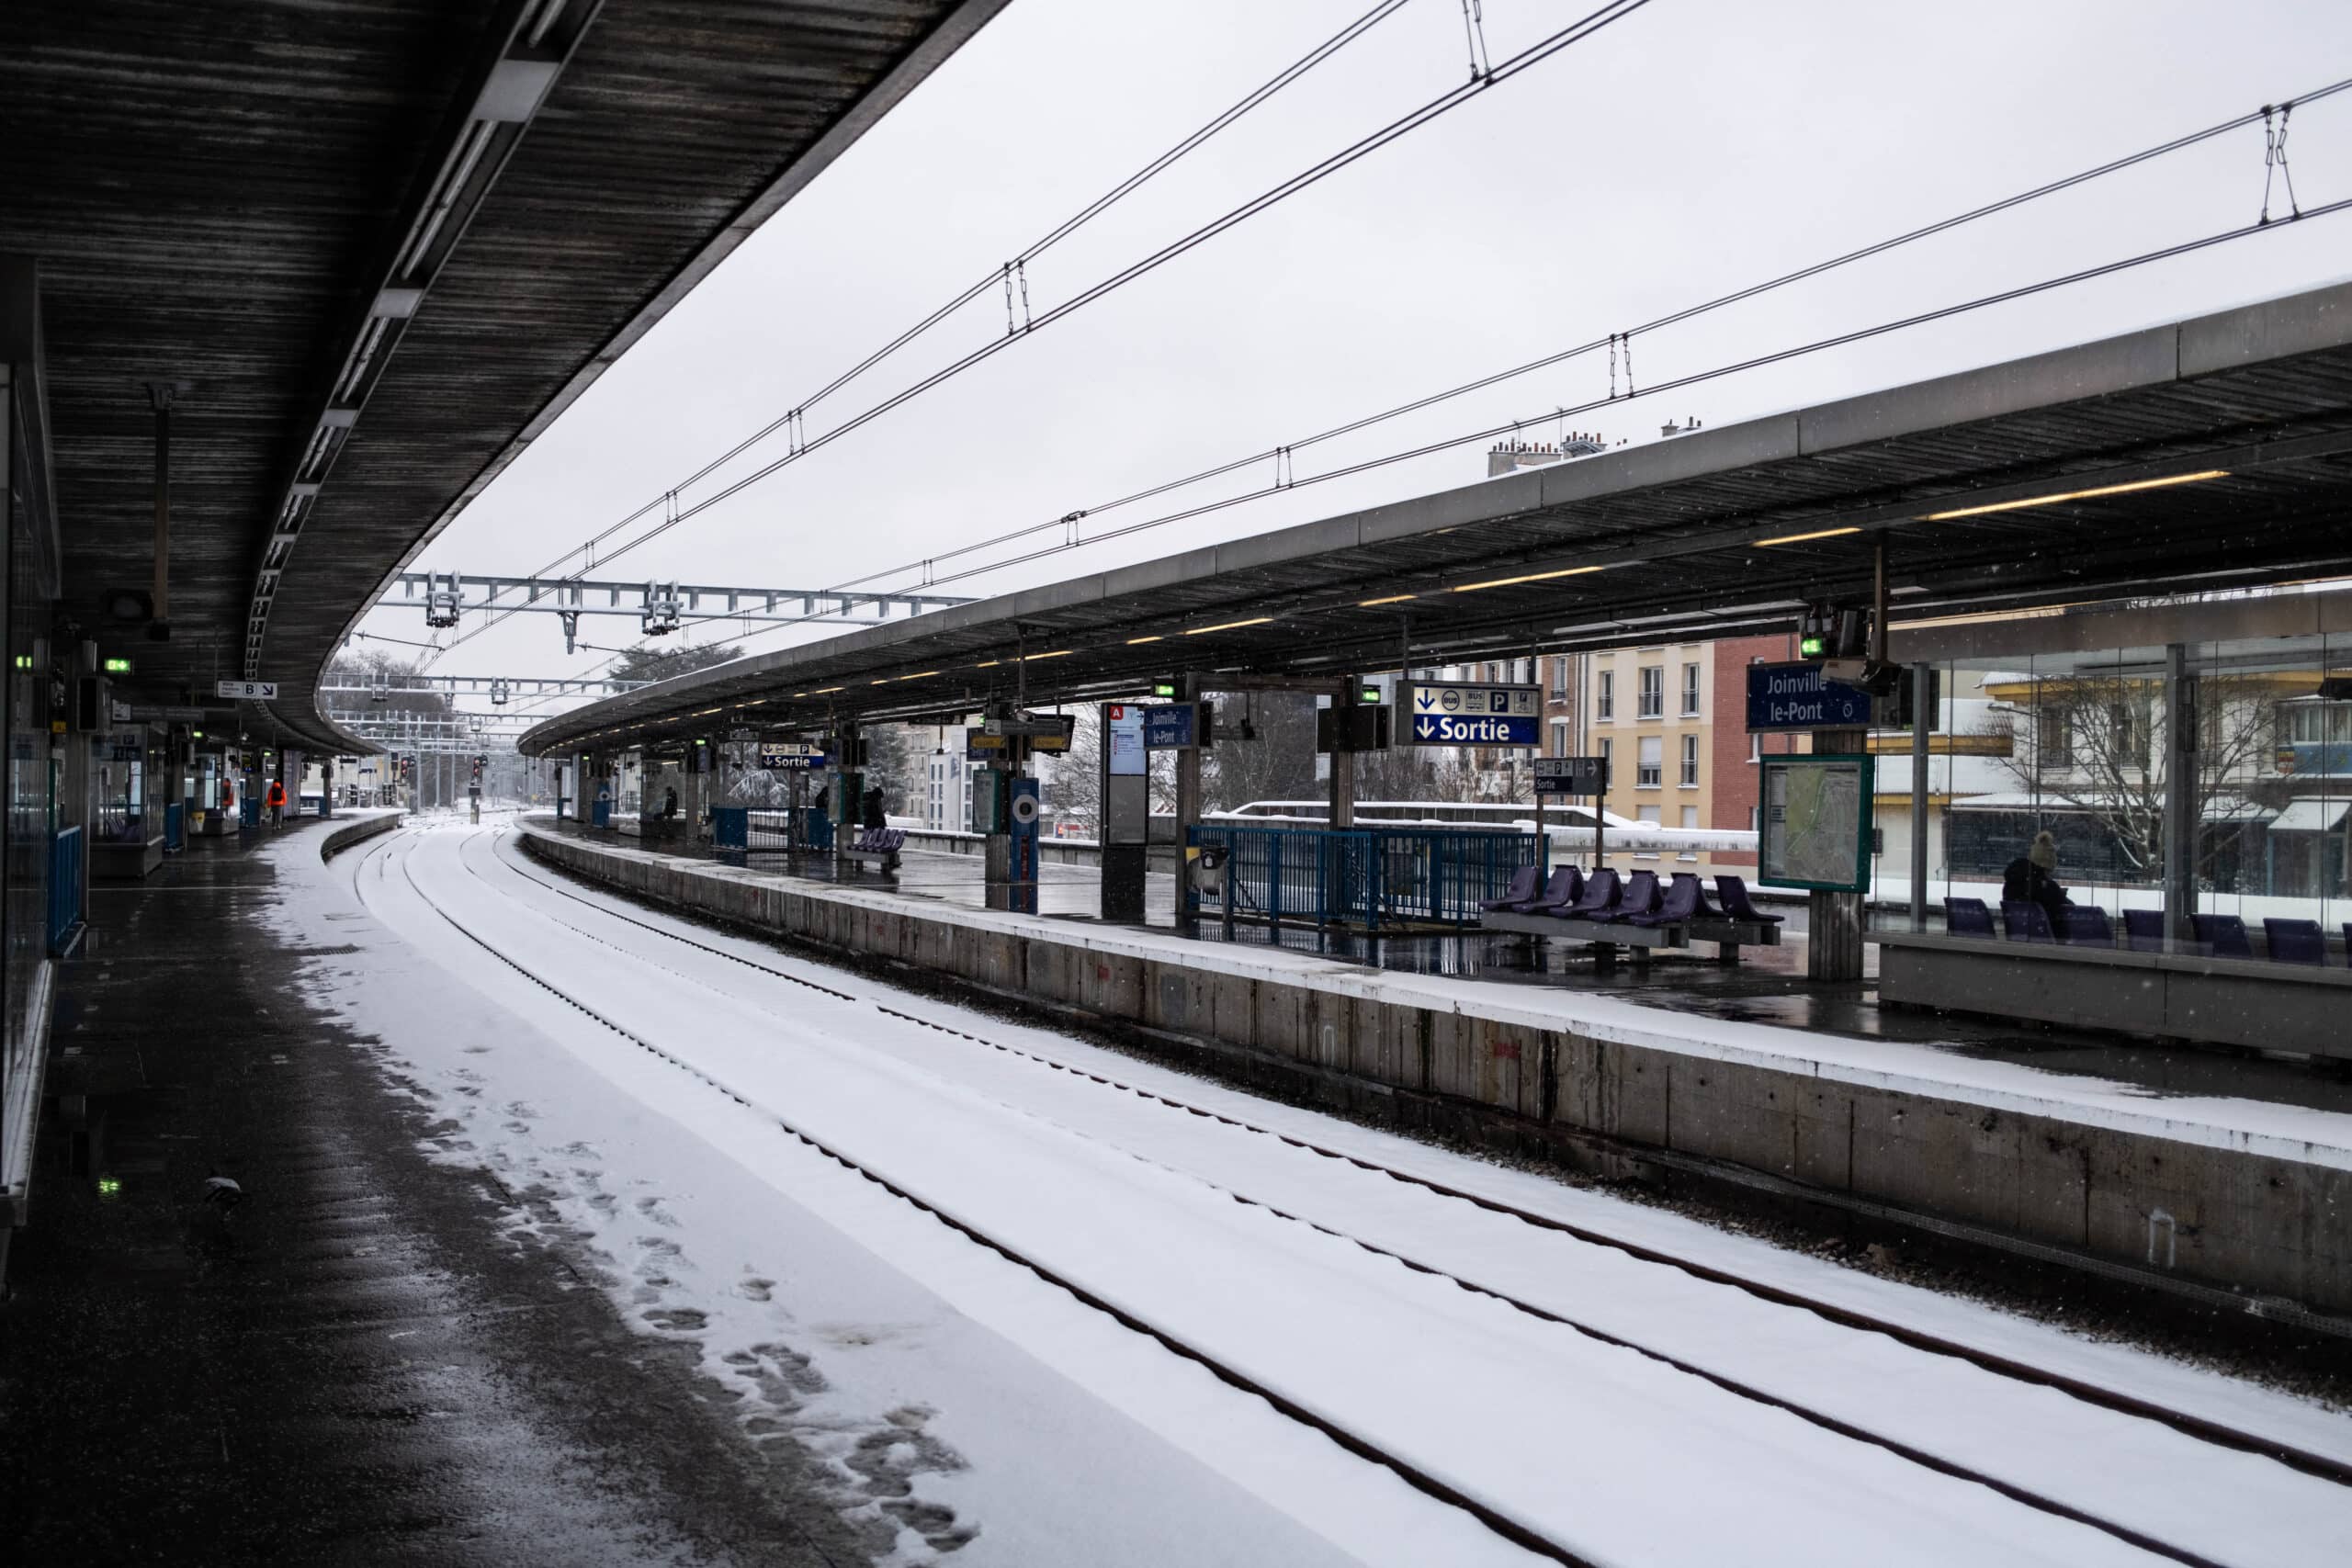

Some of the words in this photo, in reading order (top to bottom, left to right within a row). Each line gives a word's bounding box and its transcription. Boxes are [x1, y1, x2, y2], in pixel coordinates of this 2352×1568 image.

[245, 683, 254, 694] B
[1767, 671, 1827, 694] Joinville
[1443, 695, 1458, 705] BUS
[1467, 692, 1484, 700] BUS
[1494, 694, 1506, 711] P
[1112, 709, 1121, 717] A
[1152, 710, 1178, 726] Joinville
[1770, 700, 1824, 722] le-Pont
[1440, 716, 1510, 741] Sortie
[1153, 729, 1175, 743] le-Pont
[775, 756, 810, 767] Sortie
[1555, 763, 1561, 774] P
[1536, 778, 1556, 790] Sortie
